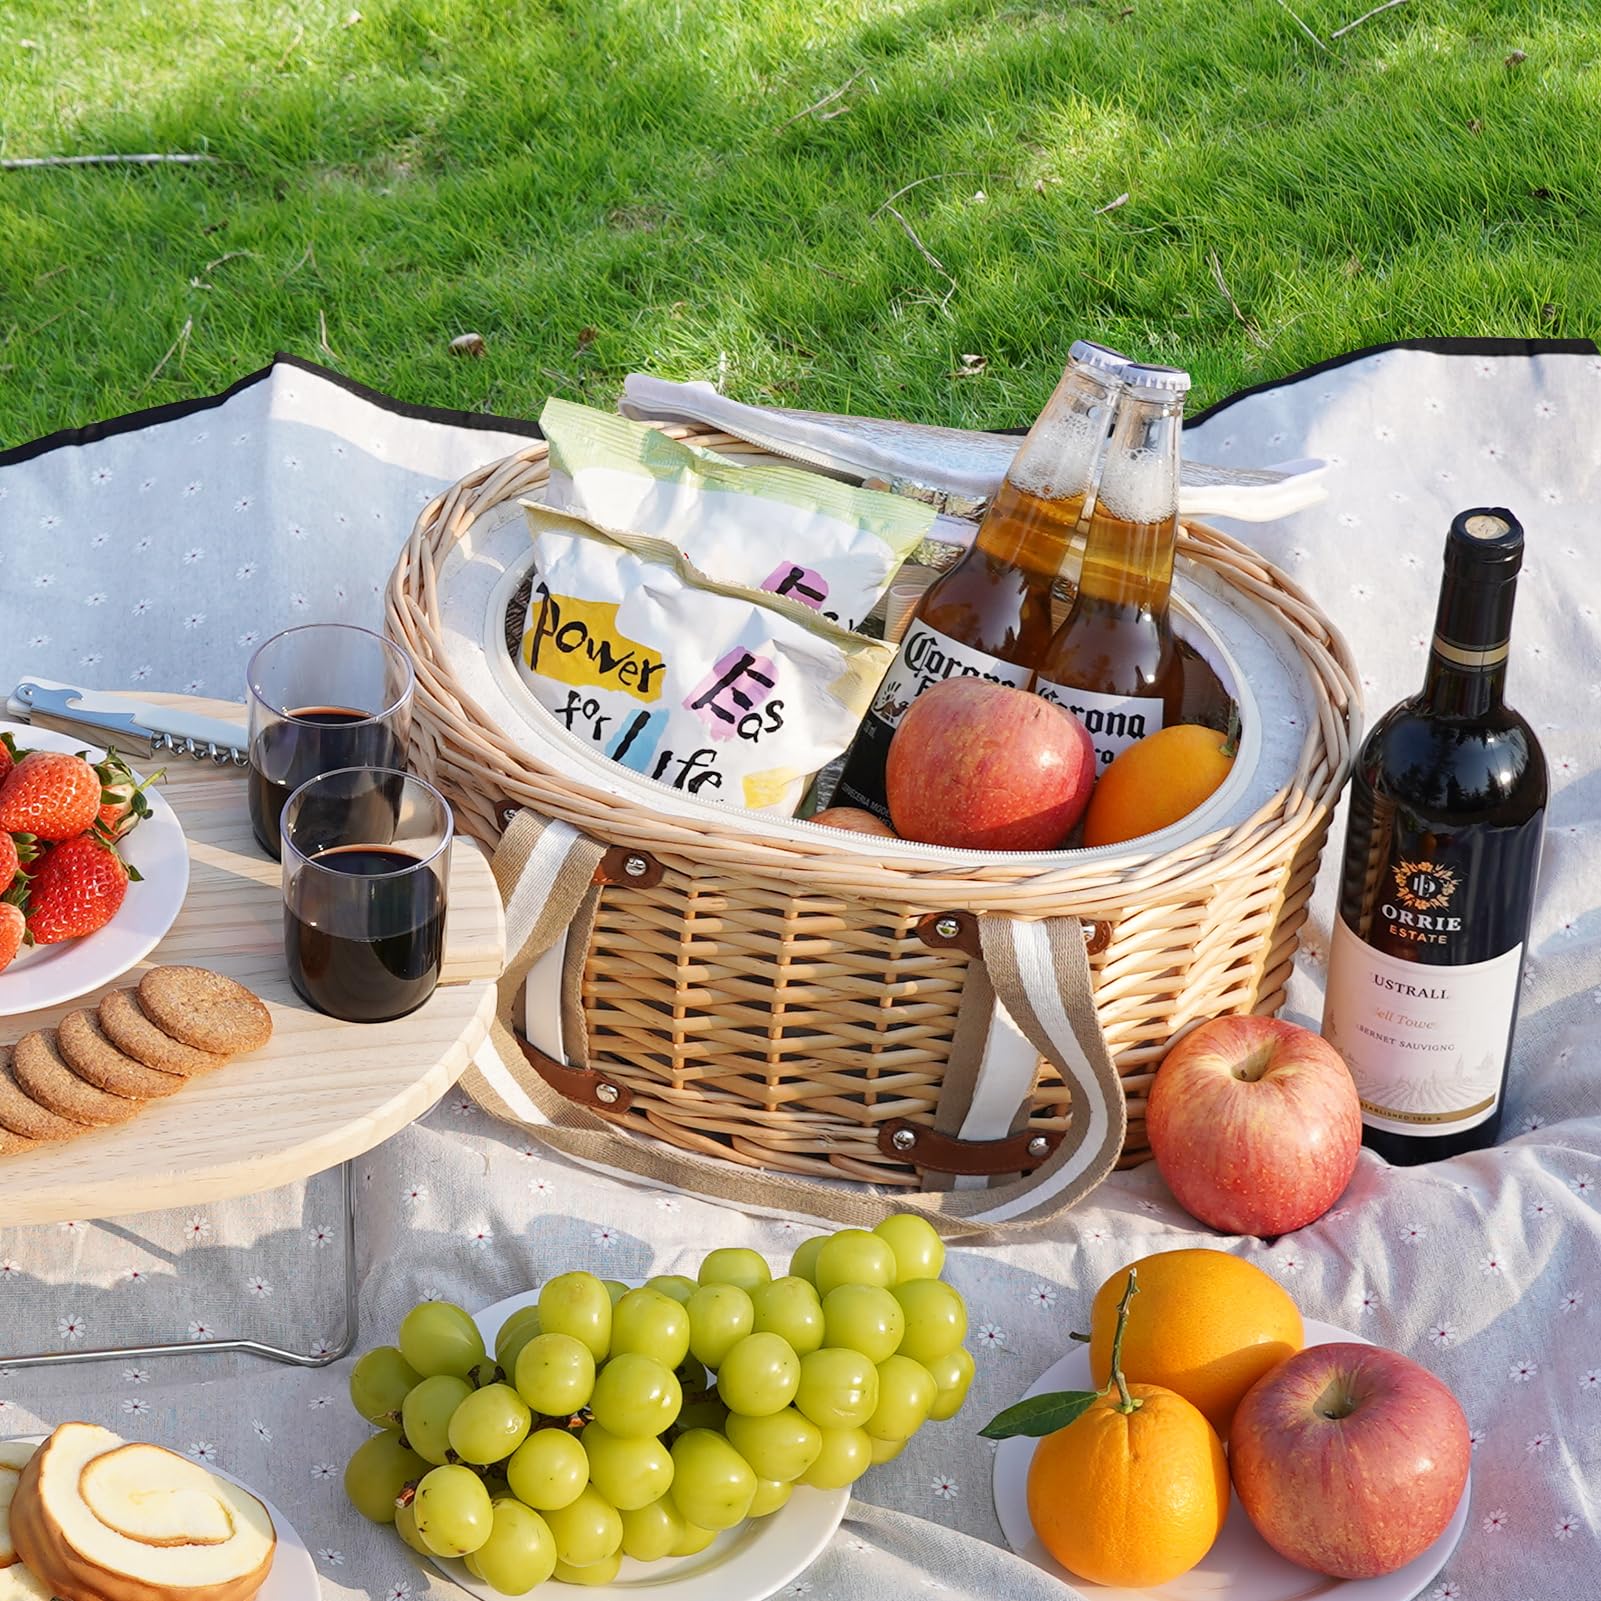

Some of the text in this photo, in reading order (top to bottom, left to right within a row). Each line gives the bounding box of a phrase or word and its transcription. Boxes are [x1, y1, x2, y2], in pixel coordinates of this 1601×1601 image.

[1381, 904, 1462, 931] ORRIE
[1389, 924, 1448, 944] ESTATE
[1356, 1024, 1396, 1045] BERNET
